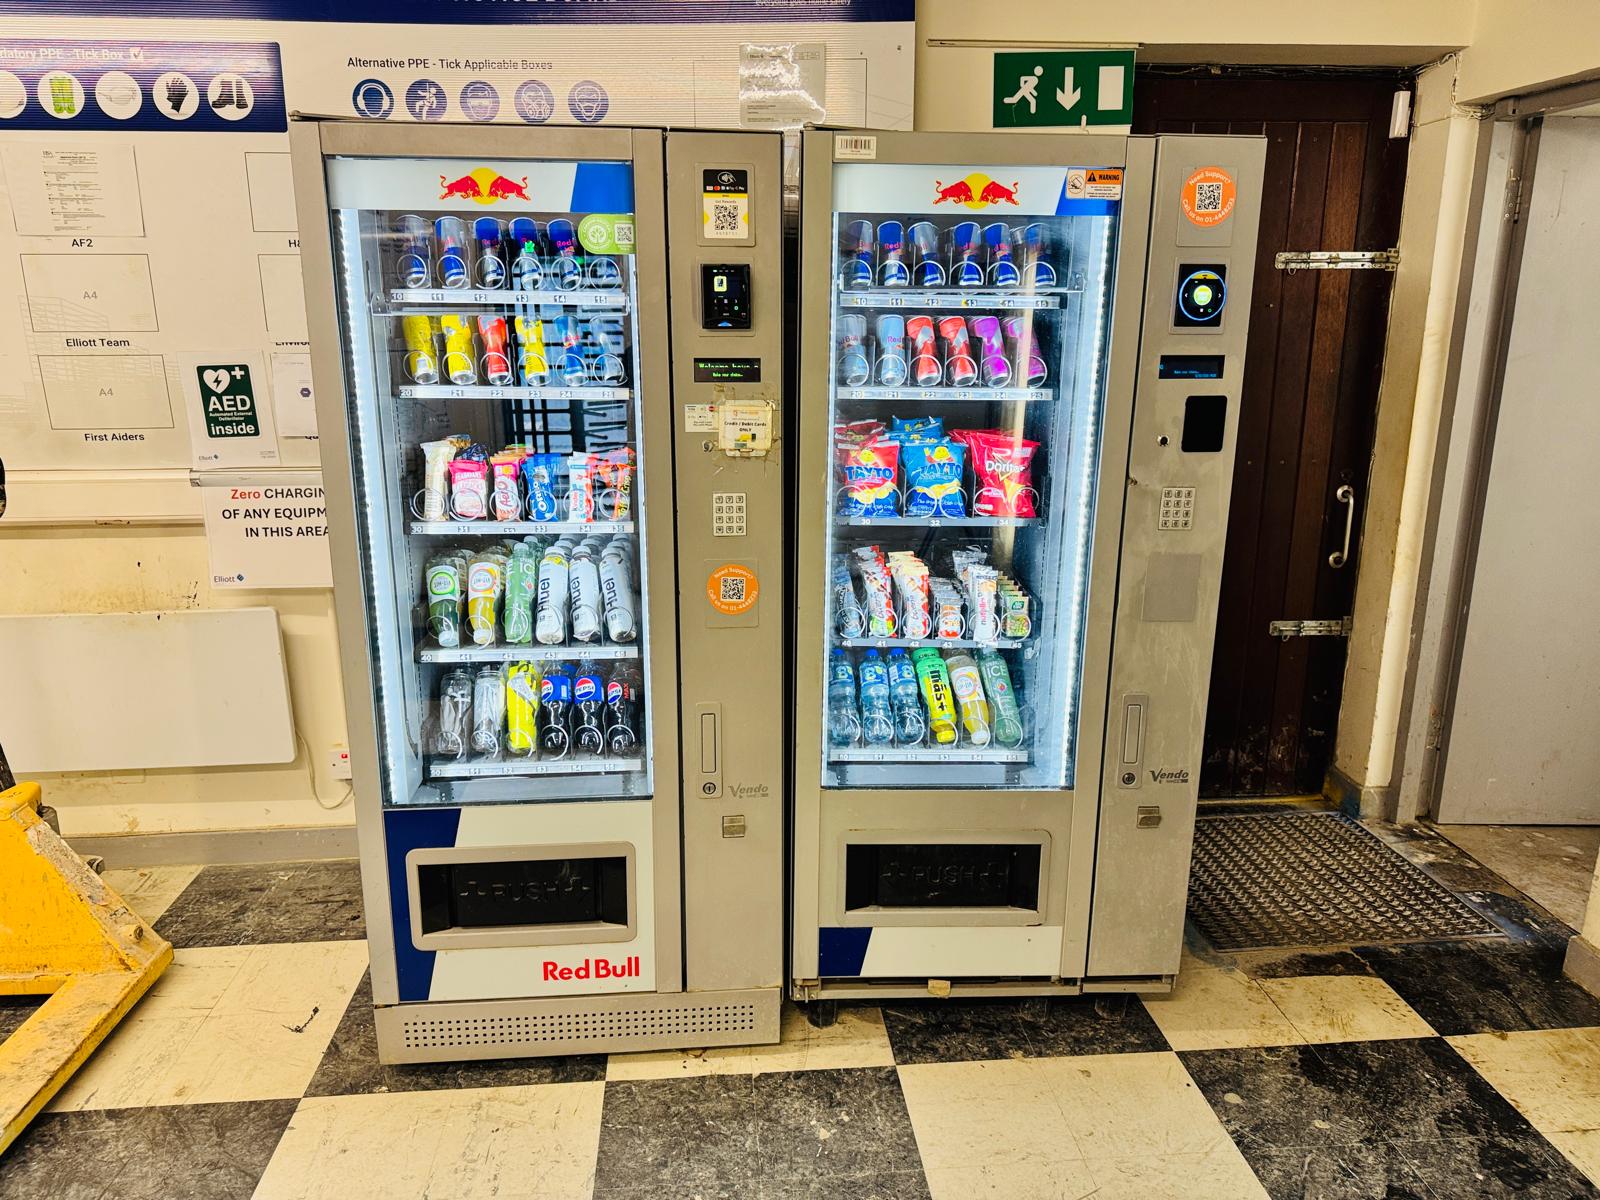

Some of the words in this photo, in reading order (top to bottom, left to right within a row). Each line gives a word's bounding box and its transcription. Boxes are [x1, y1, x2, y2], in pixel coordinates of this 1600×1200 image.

[40, 48, 63, 59] PPE
[73, 49, 98, 59] Tick
[102, 50, 124, 59] Box
[347, 57, 405, 68] Alternative
[408, 58, 430, 69] PPE
[439, 59, 462, 69] Tick
[464, 59, 518, 71] Applicable
[521, 60, 553, 70] Boxes
[1189, 171, 1204, 186] Need
[72, 238, 94, 248] AF2
[83, 291, 98, 300] A4
[66, 338, 96, 347] Elliott
[99, 338, 130, 347] Team
[99, 388, 114, 396] A4
[208, 395, 251, 411] AED
[211, 423, 255, 435] inside
[84, 433, 108, 442] First
[111, 432, 145, 442] Aiders
[844, 466, 894, 480] TAYTO
[920, 462, 963, 478] TAYTO
[231, 489, 260, 499] Zero
[222, 509, 240, 519] OF
[244, 509, 270, 518] ANY
[245, 527, 259, 537] IN
[262, 527, 292, 537] THIS
[296, 526, 329, 536] AREA
[538, 578, 550, 612] Huel
[570, 576, 581, 610] Huel
[604, 578, 618, 612] Huel
[987, 665, 1007, 678] ICE
[1149, 768, 1189, 782] Vendo
[728, 782, 768, 797] Vendo
[913, 864, 976, 884] PUSH
[543, 959, 590, 980] Red
[594, 956, 639, 978] Bull
